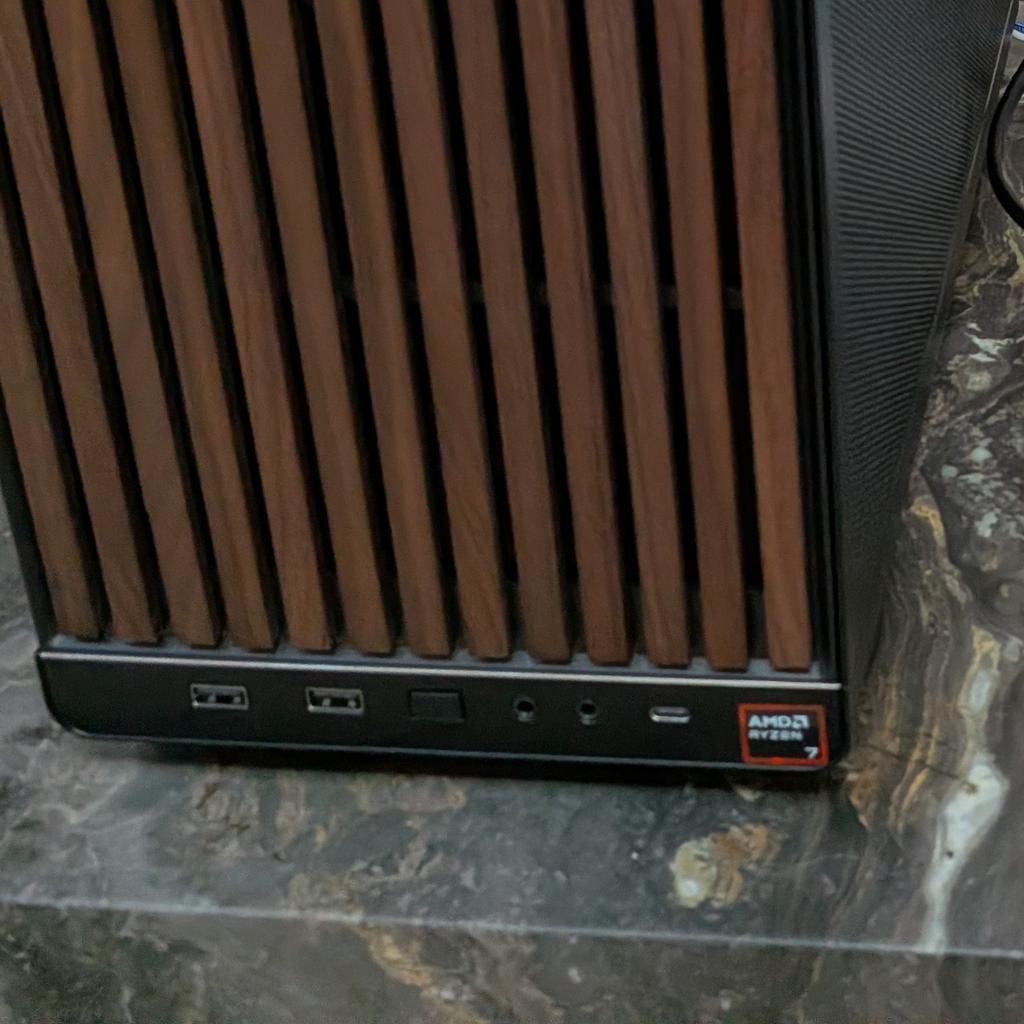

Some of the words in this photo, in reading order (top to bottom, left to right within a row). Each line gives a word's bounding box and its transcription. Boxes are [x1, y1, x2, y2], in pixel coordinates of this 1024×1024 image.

[748, 715, 791, 728] AMD
[748, 729, 804, 741] RYZEN
[804, 746, 820, 759] 7
